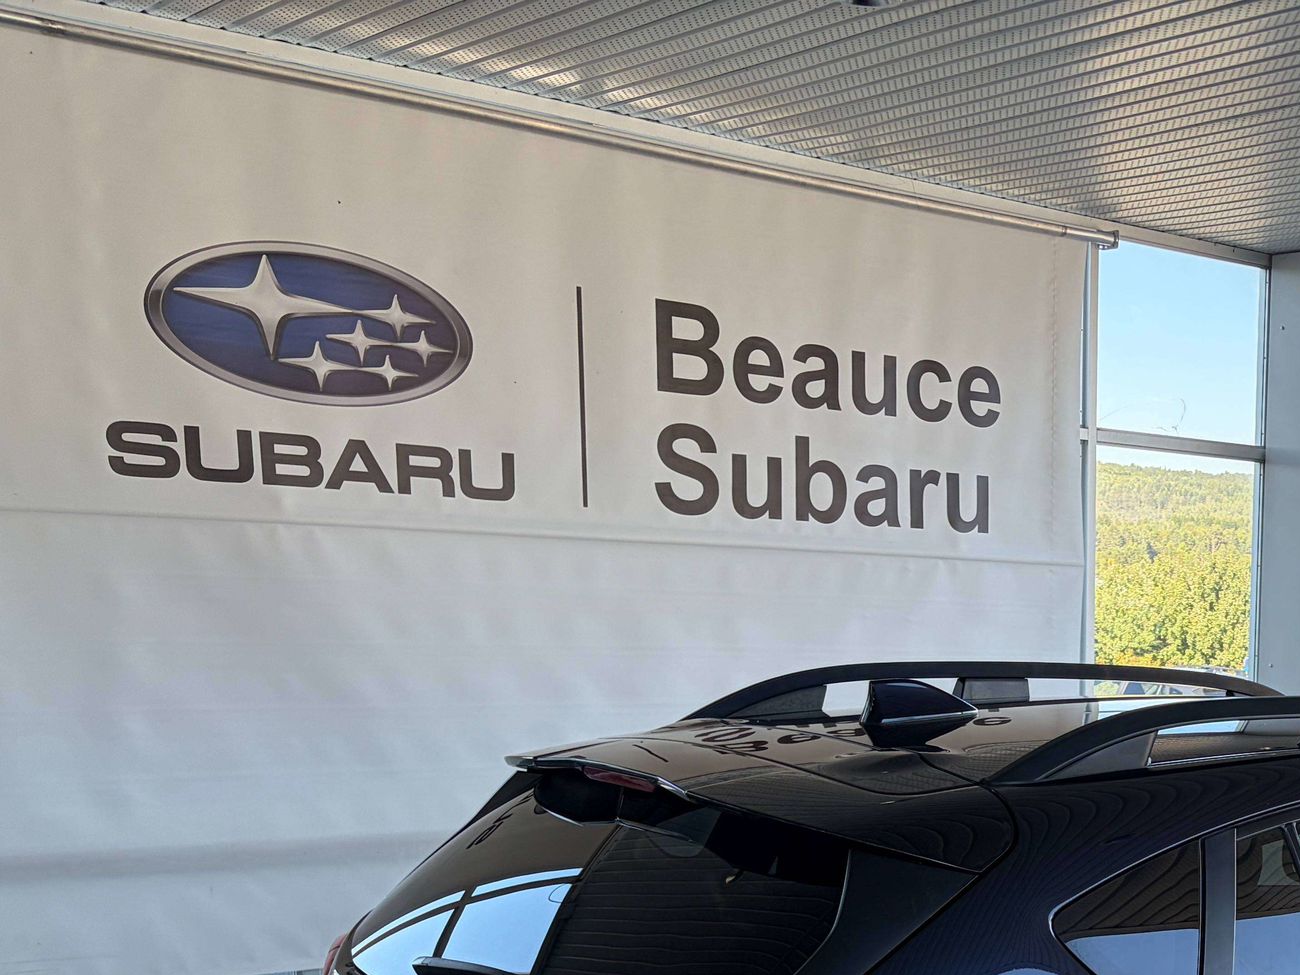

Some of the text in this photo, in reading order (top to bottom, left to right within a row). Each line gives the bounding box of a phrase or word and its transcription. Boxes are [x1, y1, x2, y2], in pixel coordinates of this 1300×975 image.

[655, 299, 1003, 429] Beauce
[105, 420, 516, 502] SUBARU
[654, 423, 991, 534] Subaru
